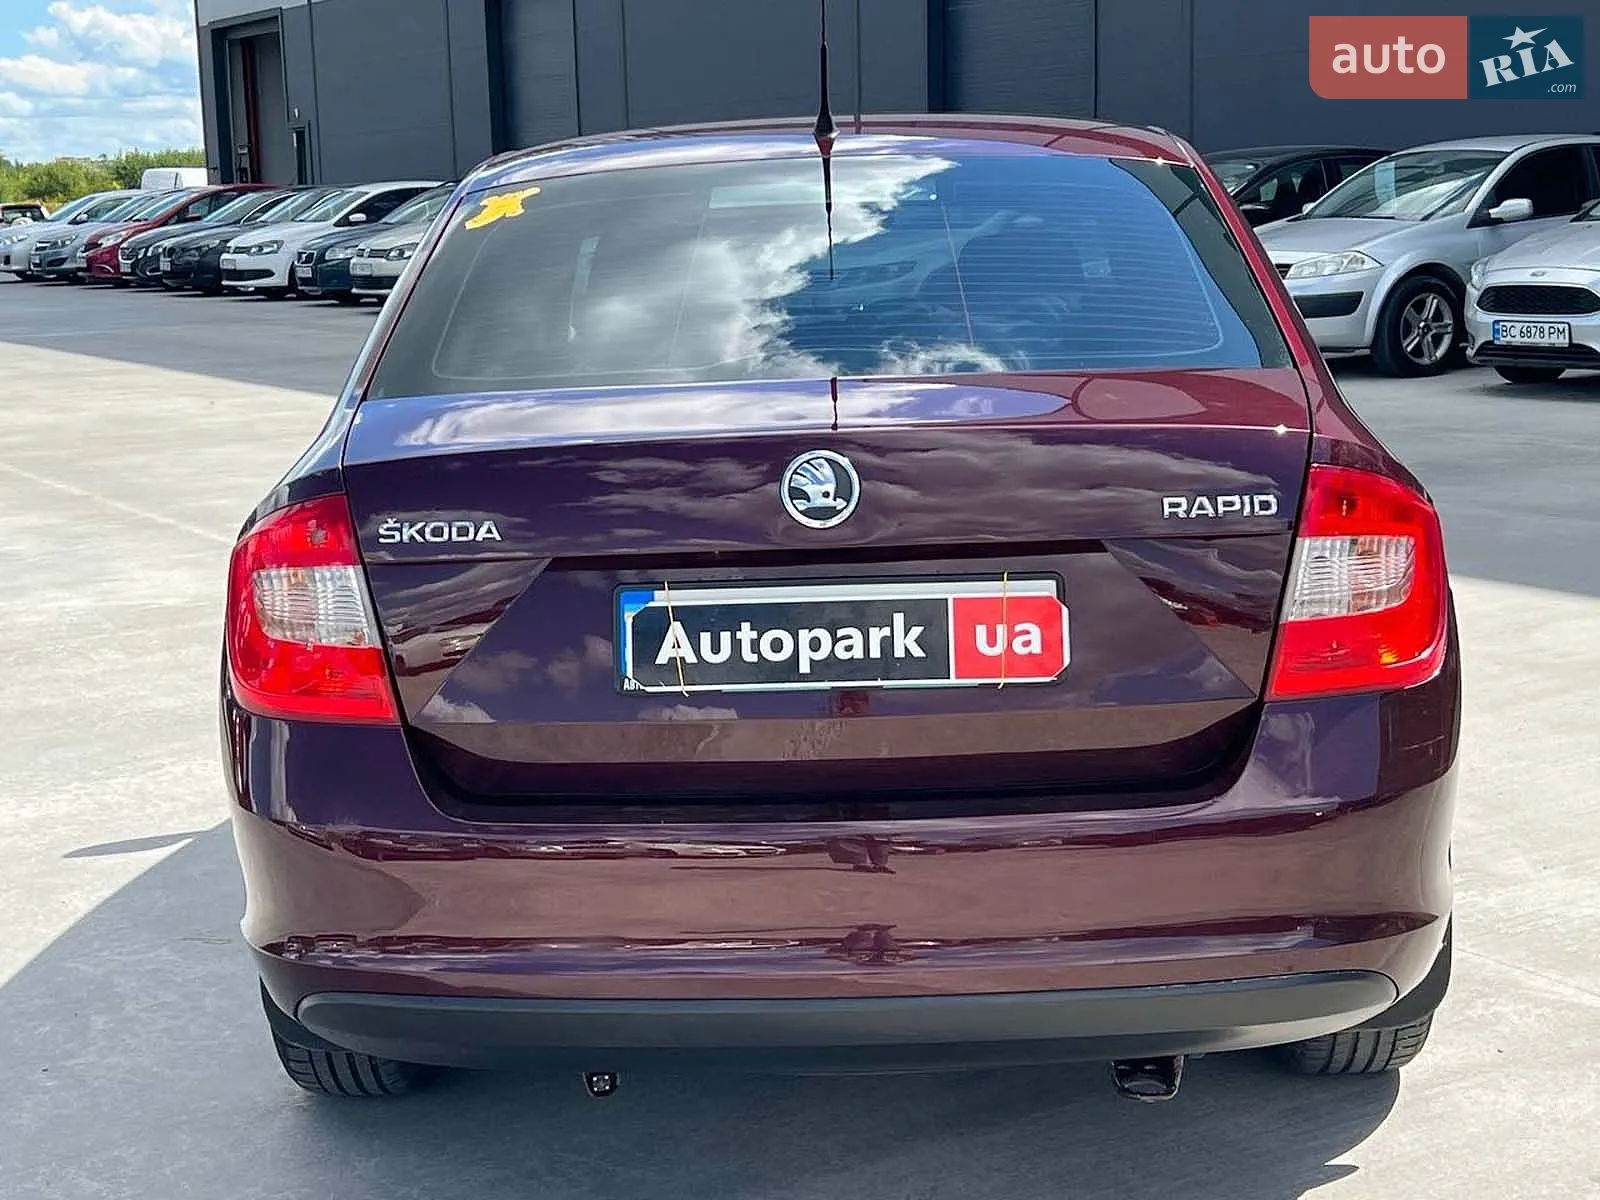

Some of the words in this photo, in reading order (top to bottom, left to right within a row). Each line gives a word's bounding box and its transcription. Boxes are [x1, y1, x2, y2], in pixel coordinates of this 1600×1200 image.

[1501, 324, 1517, 338] BC
[1519, 325, 1545, 339] 6878
[1548, 326, 1566, 340] PM
[1162, 494, 1278, 518] RAPID
[378, 518, 502, 543] ŠKODA
[654, 612, 926, 674] Autopark
[974, 622, 1043, 656] ua
